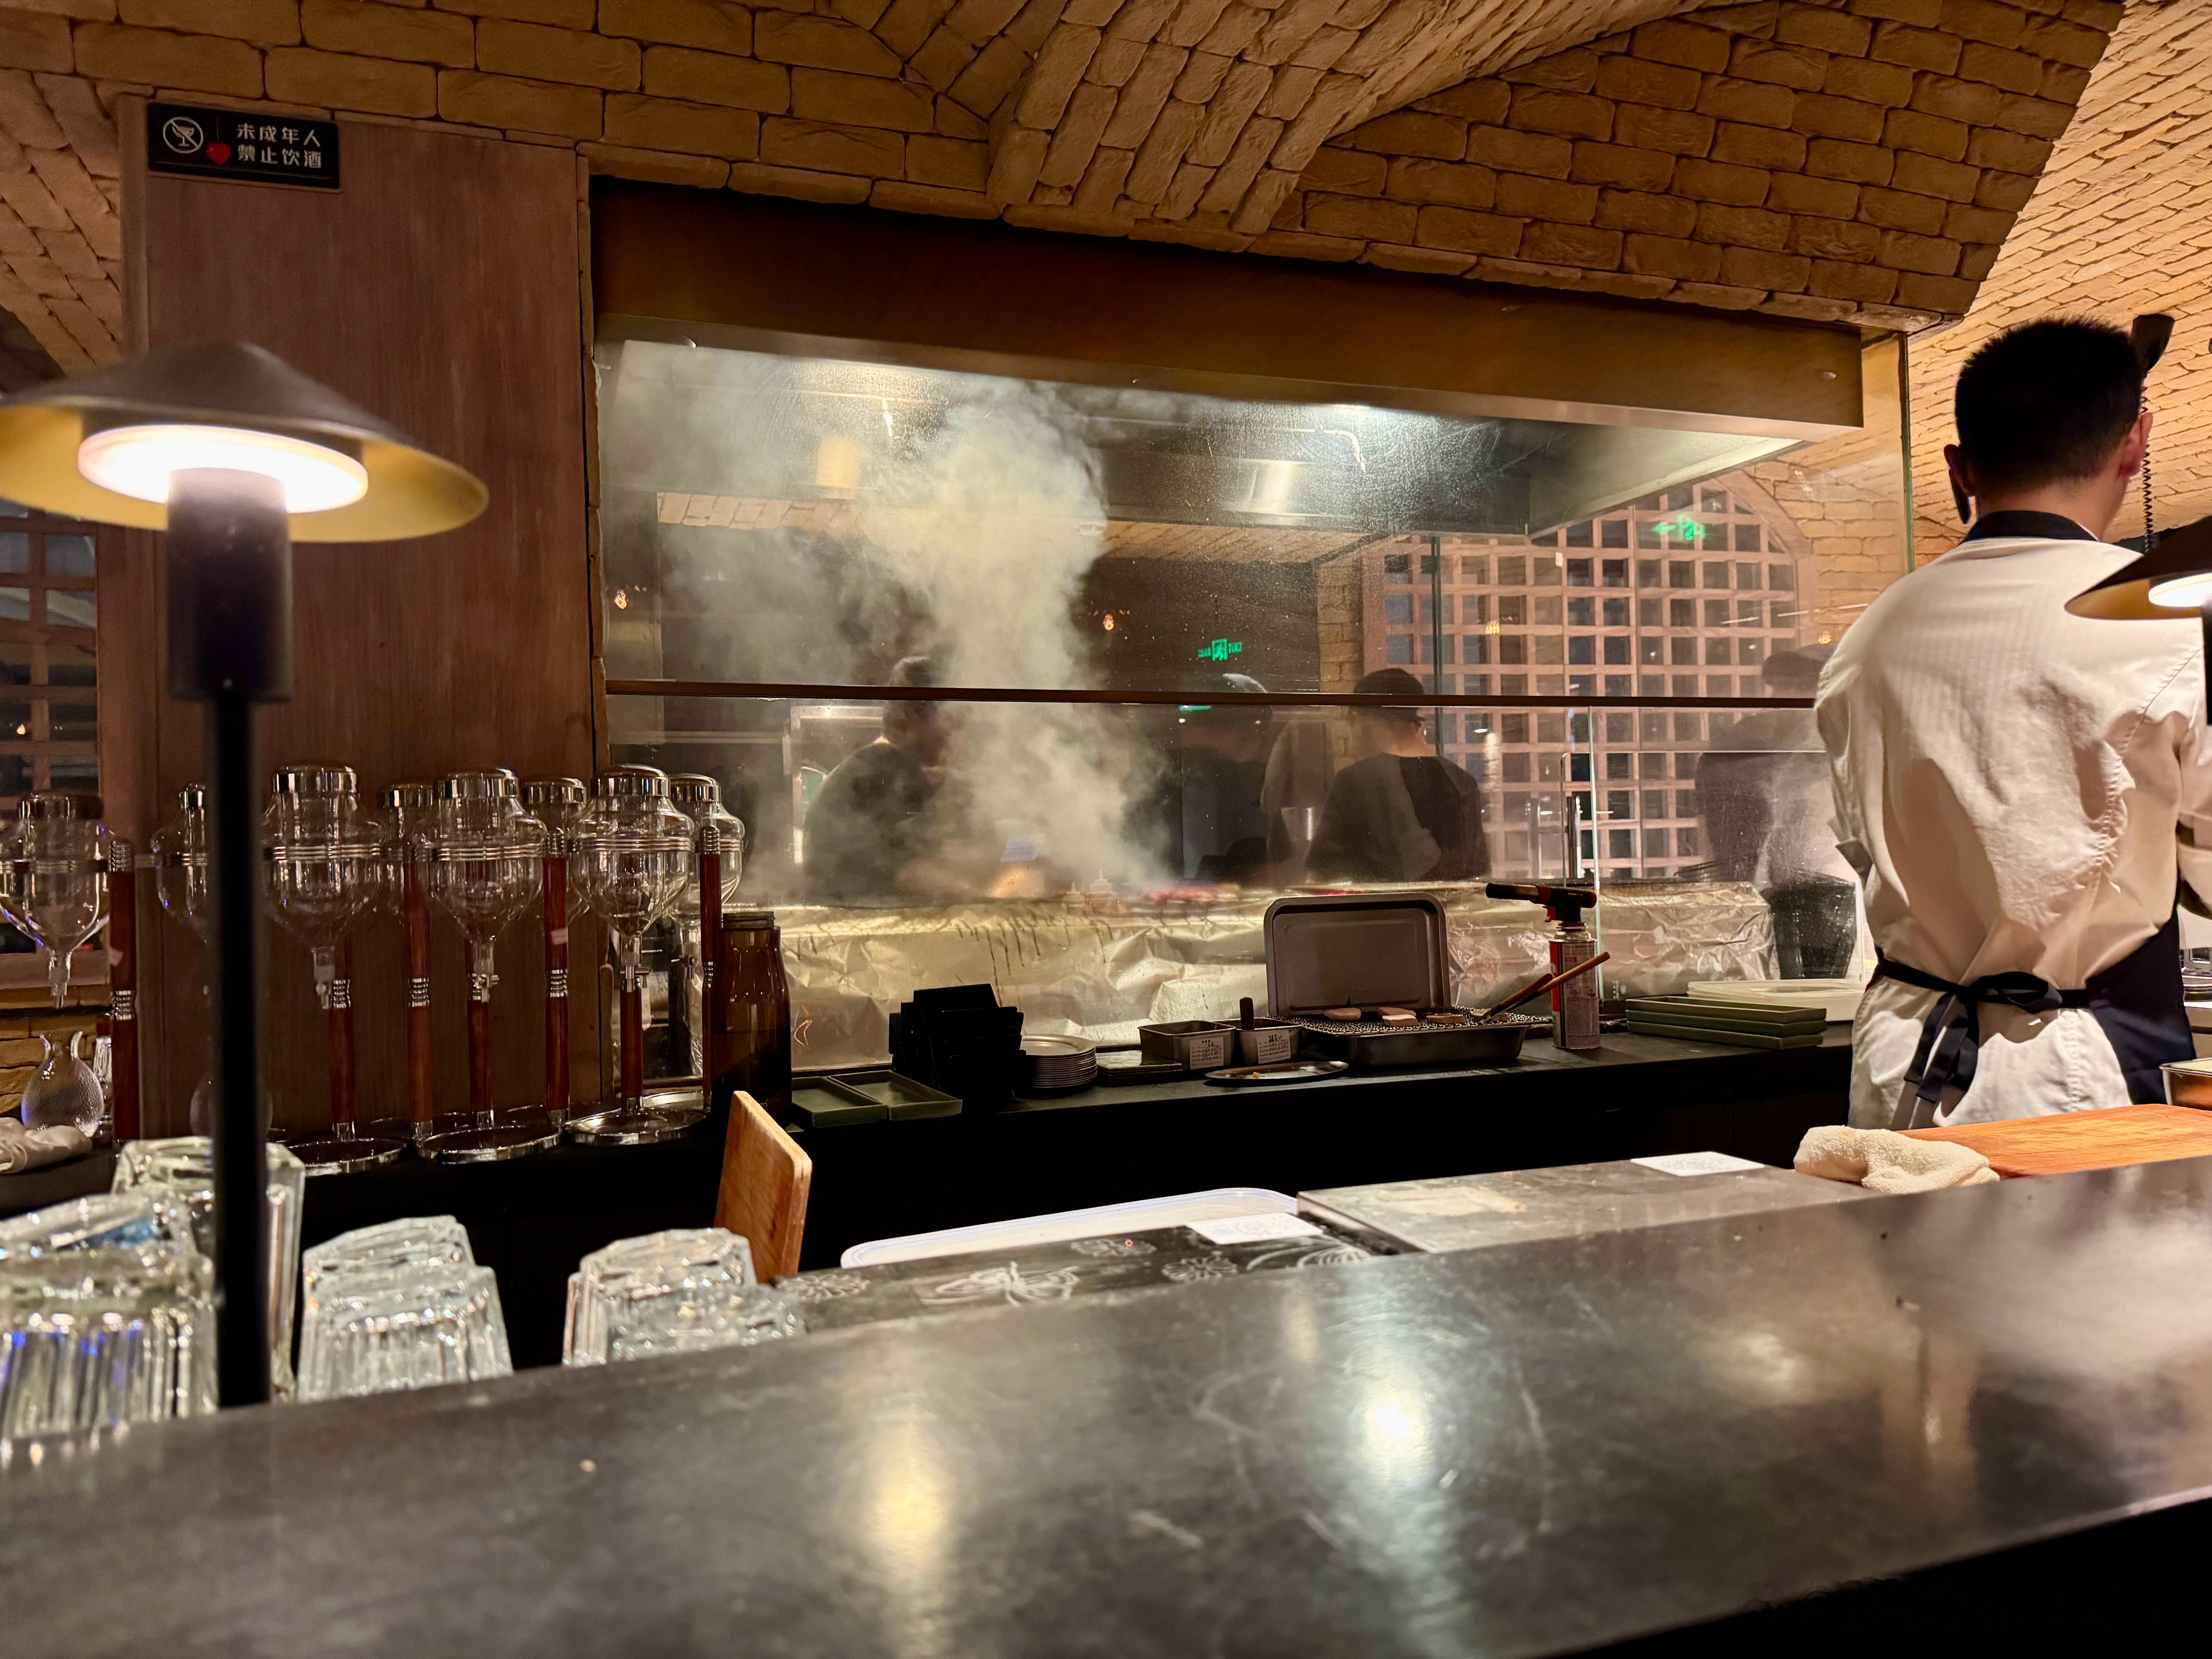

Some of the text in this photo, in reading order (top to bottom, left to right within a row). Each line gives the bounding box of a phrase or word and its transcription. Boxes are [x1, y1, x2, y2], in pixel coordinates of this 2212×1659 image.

[237, 122, 321, 147] 未成年人
[238, 144, 321, 168] 禁止饮酒
